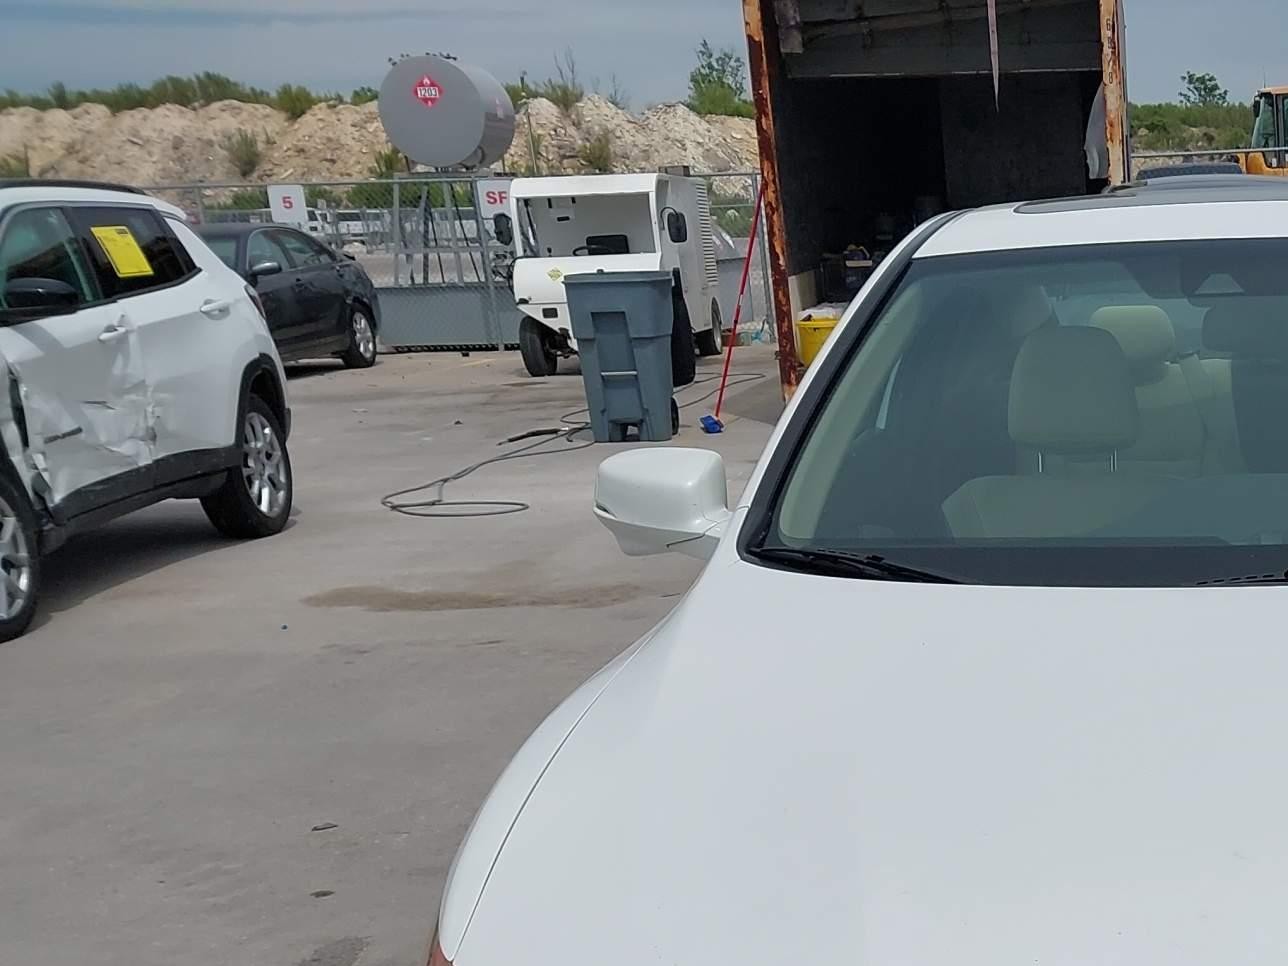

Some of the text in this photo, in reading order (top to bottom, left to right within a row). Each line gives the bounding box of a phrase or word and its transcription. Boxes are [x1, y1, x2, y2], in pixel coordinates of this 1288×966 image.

[419, 87, 438, 97] 1203
[282, 196, 293, 209] 5
[486, 191, 507, 205] SF
